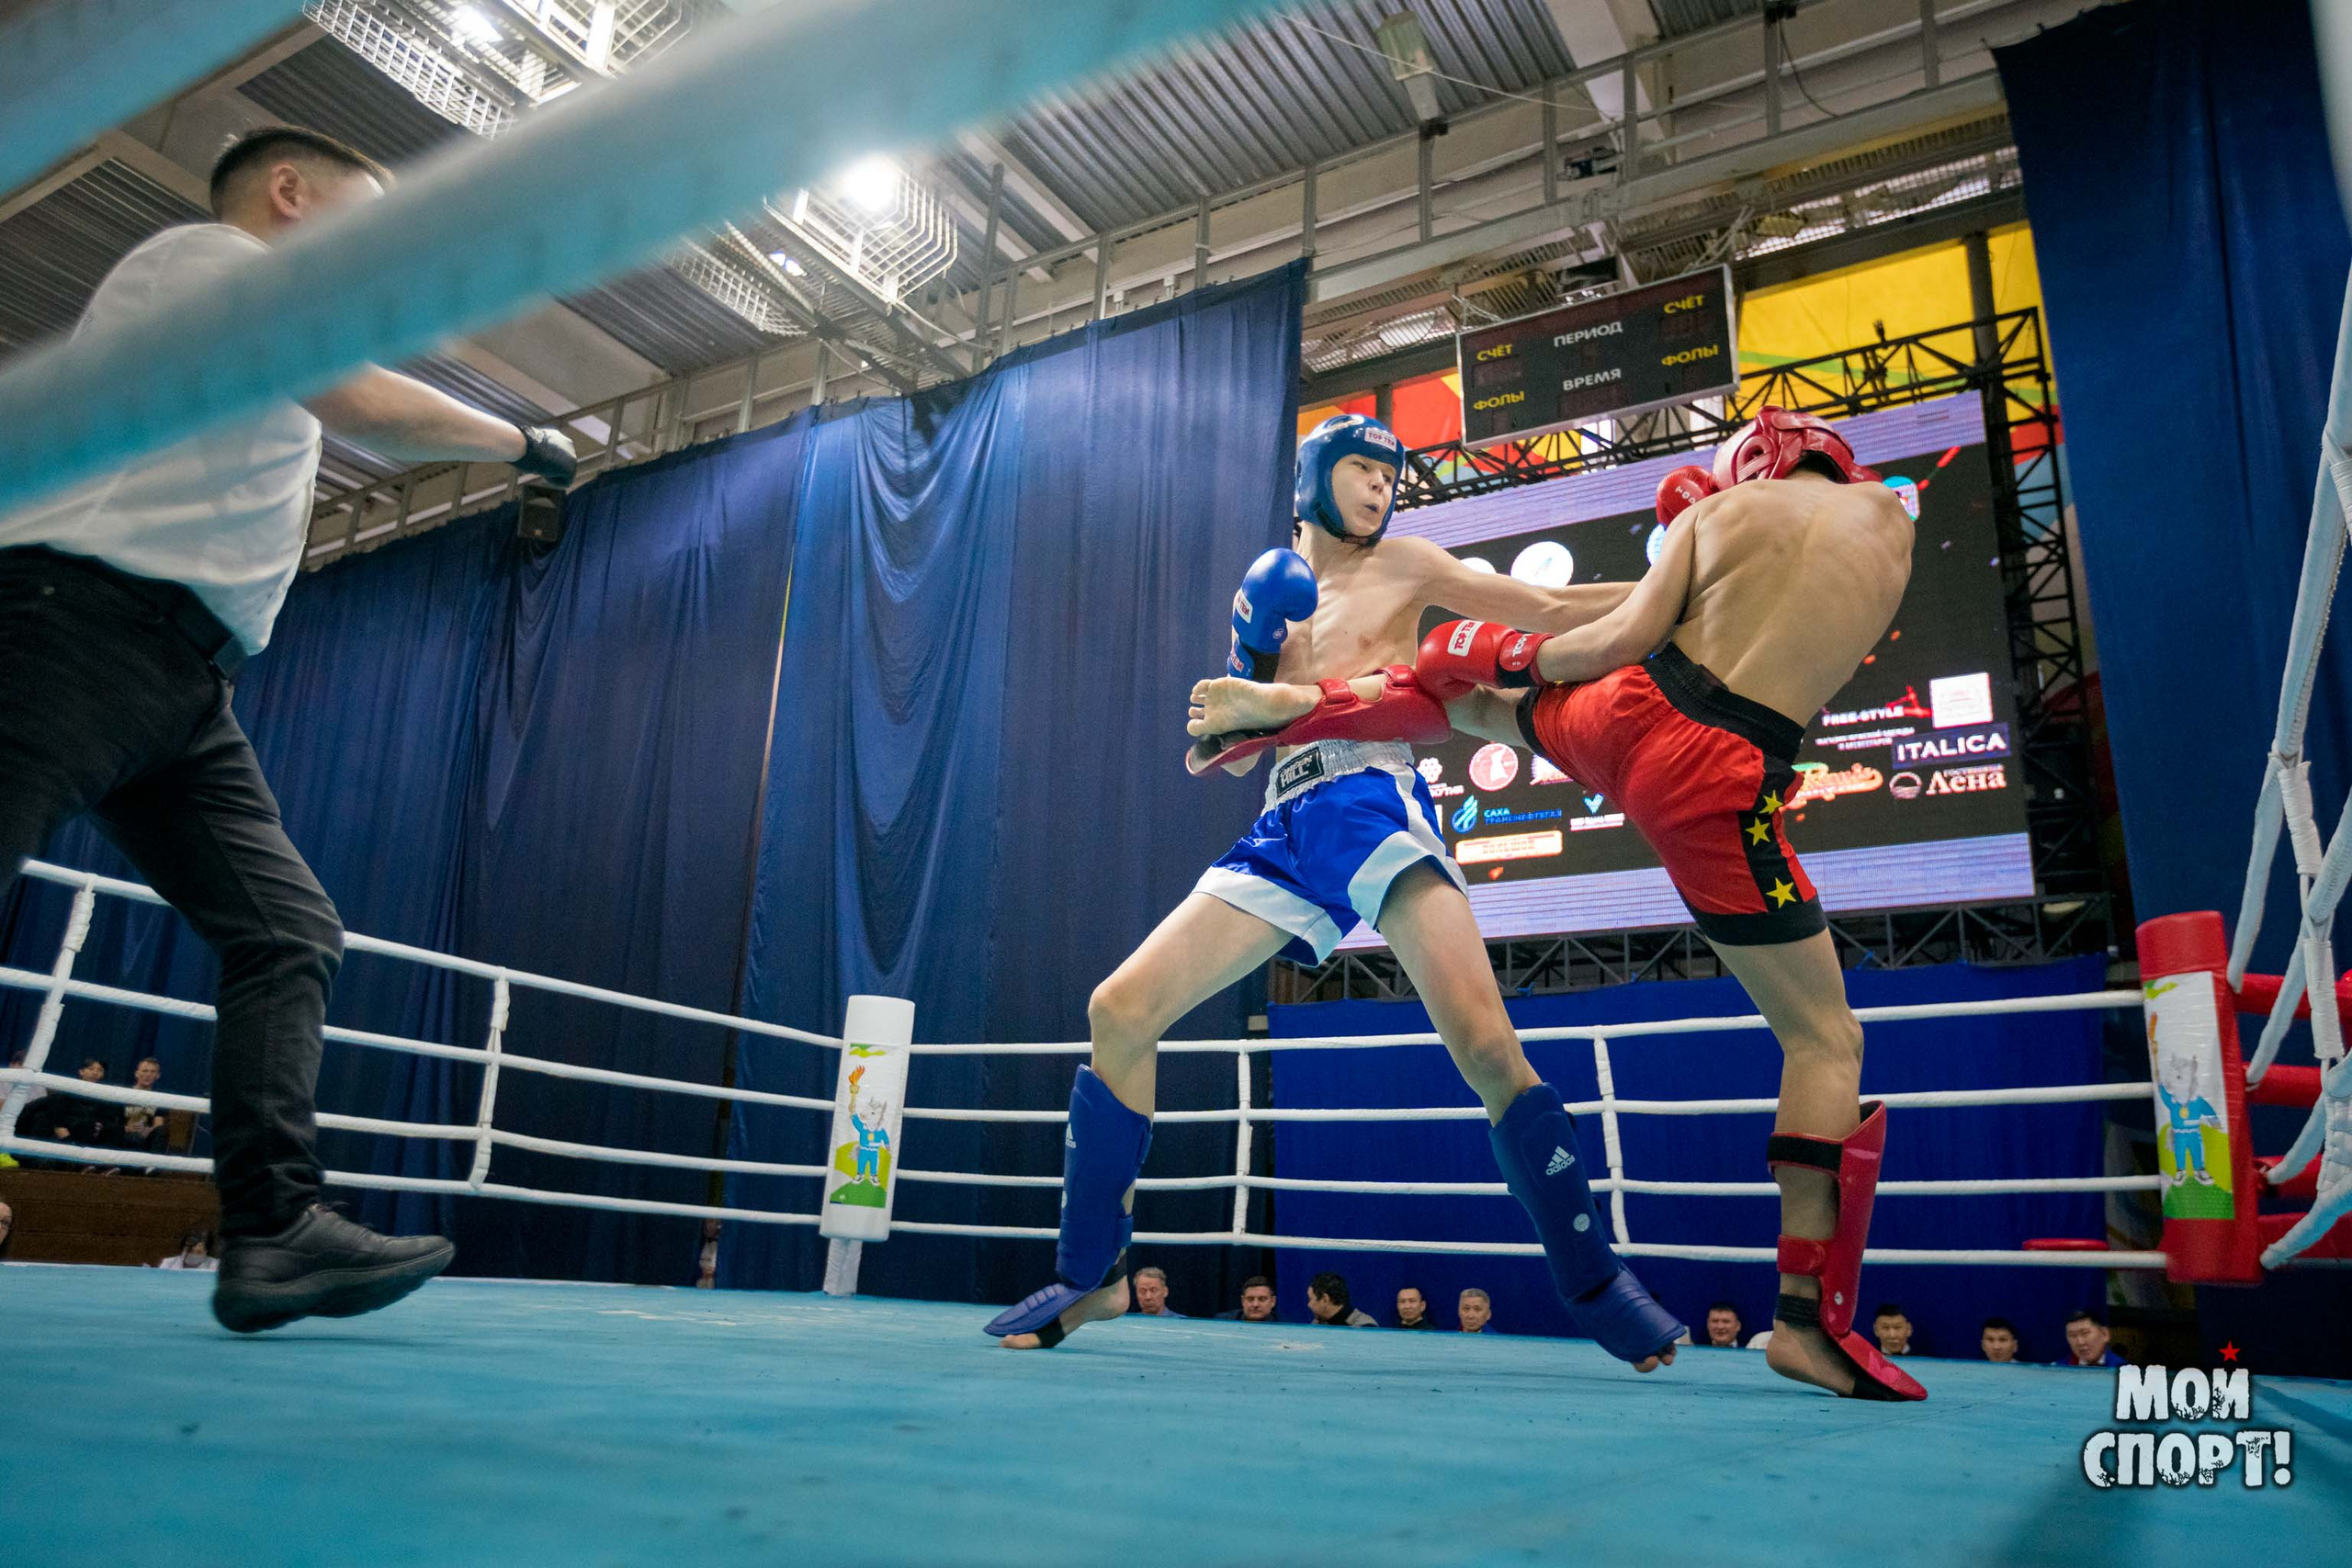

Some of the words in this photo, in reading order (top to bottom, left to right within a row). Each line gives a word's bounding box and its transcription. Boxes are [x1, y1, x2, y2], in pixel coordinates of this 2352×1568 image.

[1663, 294, 1704, 314] СЧЁТ
[1554, 321, 1623, 348] ПЕРИОД
[1476, 344, 1513, 361] СЧЁТ
[1661, 344, 1720, 366] ФОЛЫ
[1563, 367, 1622, 390] ВРЕМЯ
[1473, 390, 1525, 411] ФОЛЫ
[1368, 432, 1383, 440] TOP
[1453, 632, 1467, 649] TOP
[1896, 732, 2007, 762] ITALICA
[1925, 769, 2007, 796] Лена
[1483, 807, 1510, 818] САХА
[1545, 1155, 1576, 1176] adidas
